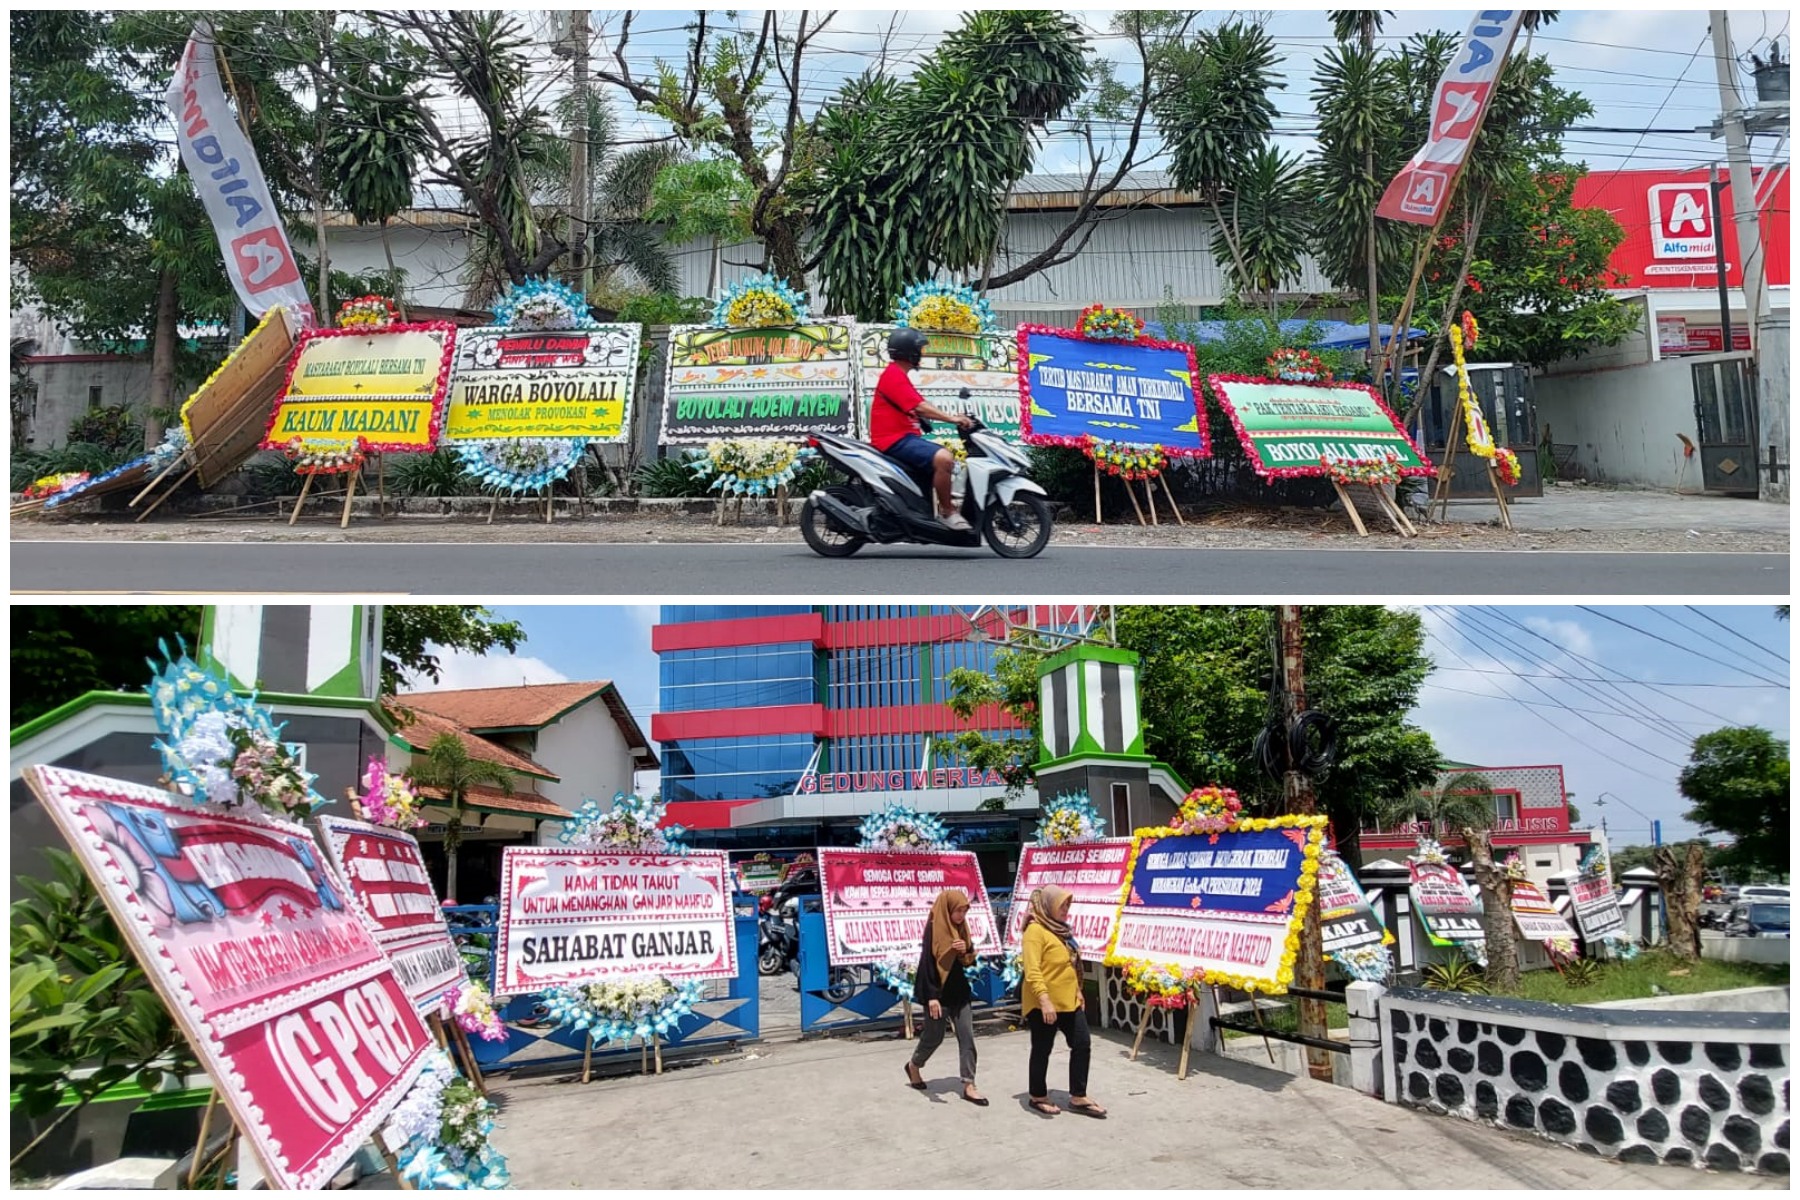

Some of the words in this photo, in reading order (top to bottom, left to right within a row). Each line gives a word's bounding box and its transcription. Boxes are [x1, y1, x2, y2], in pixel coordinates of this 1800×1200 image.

[303, 361, 346, 377] MASYARAKAT
[344, 359, 379, 376] BOYOLALI
[379, 358, 412, 375] BERSAMA
[413, 358, 426, 375] TNI
[464, 383, 523, 406] WARGA
[528, 381, 617, 403] BOYOLALI
[1038, 366, 1065, 388] TERTIB
[1066, 369, 1114, 394] MASYARAKAT
[1116, 375, 1138, 397] AMAN
[1138, 377, 1185, 402] TERKENDALI
[487, 407, 531, 421] MENOLAK
[535, 406, 587, 420] PROVOKASI
[676, 395, 746, 420] BOYOLALI
[750, 395, 795, 419] ADEM
[797, 394, 841, 418] AYEM
[1066, 390, 1134, 418] BERSAMA
[1137, 397, 1162, 420] TNI
[282, 410, 337, 433] KAUM
[338, 410, 420, 433] MADANI
[1264, 442, 1353, 462] BOYOLALI
[801, 770, 904, 793] GEDUNG
[911, 765, 1034, 790] MERBA
[1086, 848, 1126, 864] SEMBUH
[565, 875, 597, 891] KAMI
[602, 875, 638, 891] TIDAK
[642, 874, 680, 890] TAKUT
[523, 897, 558, 914] UNTUK
[561, 895, 628, 913] MENANGKAN
[633, 894, 673, 910] GANJAR
[674, 893, 714, 909] MAHFUD
[845, 920, 884, 945] ALIANSI
[522, 933, 627, 965] SAHABAT
[631, 930, 715, 957] GANJAR
[1193, 928, 1230, 961] GANJAR
[1227, 932, 1272, 967] MAHFUD
